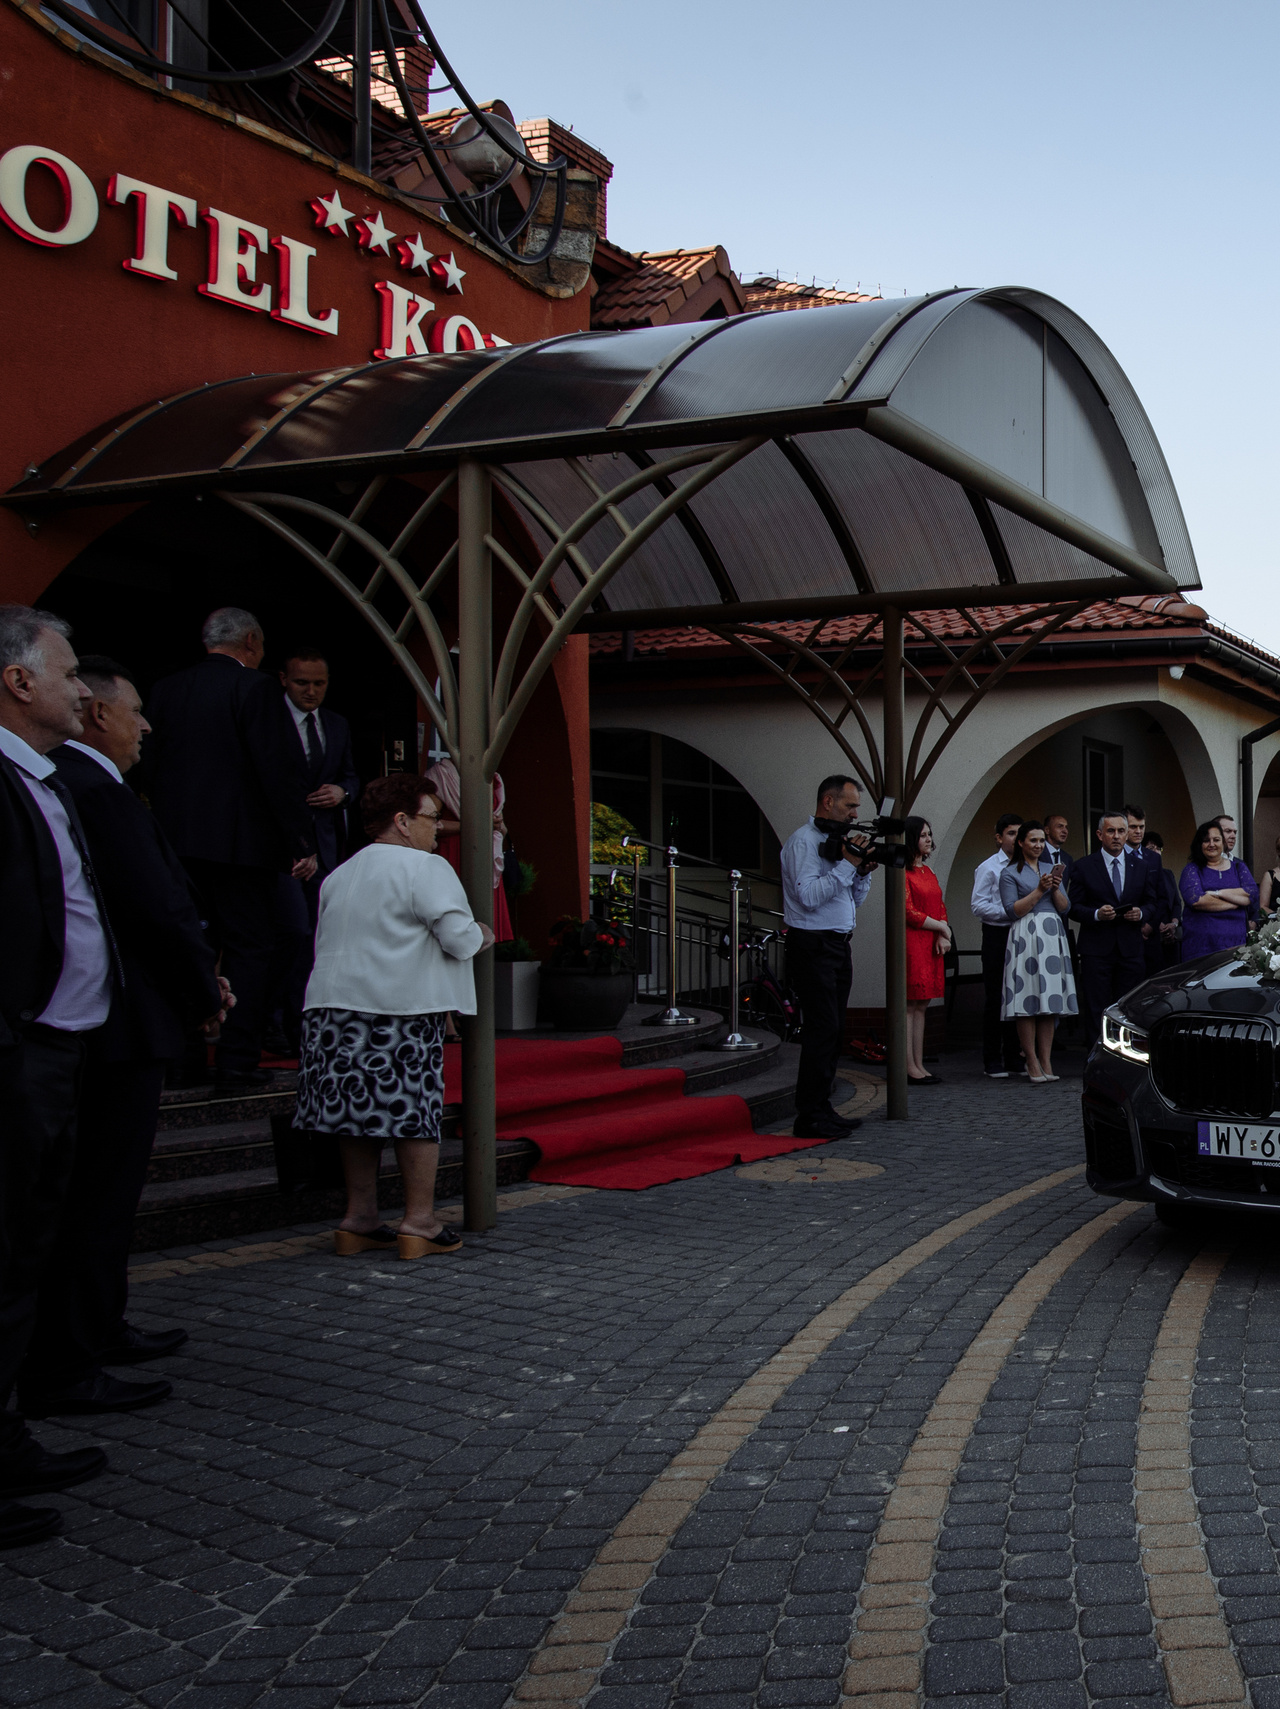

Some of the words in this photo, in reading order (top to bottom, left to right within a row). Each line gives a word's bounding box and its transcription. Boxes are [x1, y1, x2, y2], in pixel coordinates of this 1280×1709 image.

[375, 280, 513, 358] KO
[1200, 1142, 1209, 1150] PL
[1215, 1125, 1249, 1156] WY
